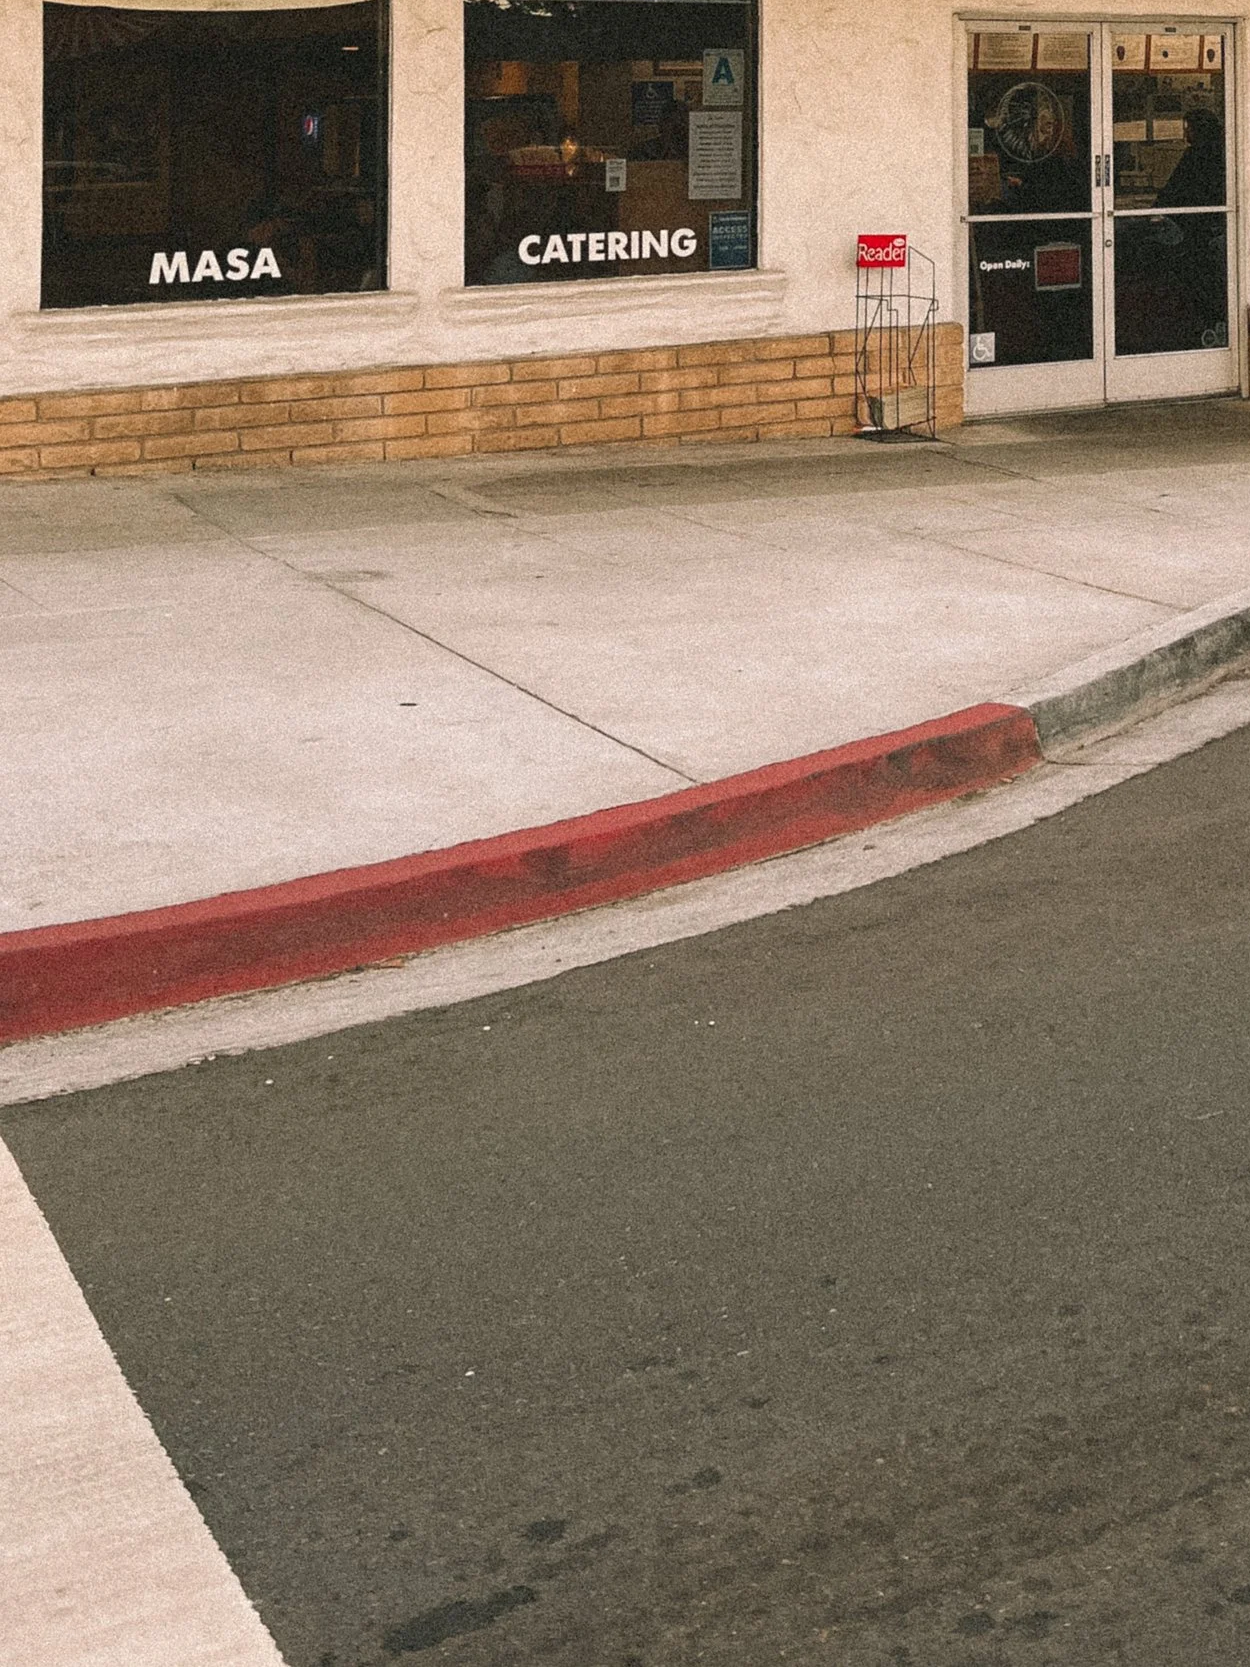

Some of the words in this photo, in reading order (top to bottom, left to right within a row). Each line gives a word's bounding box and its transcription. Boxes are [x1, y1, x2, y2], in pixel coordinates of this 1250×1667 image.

[712, 57, 735, 84] A
[518, 228, 697, 265] CATERING
[858, 242, 906, 262] Reader
[149, 248, 281, 284] MASA
[980, 261, 1004, 272] Open
